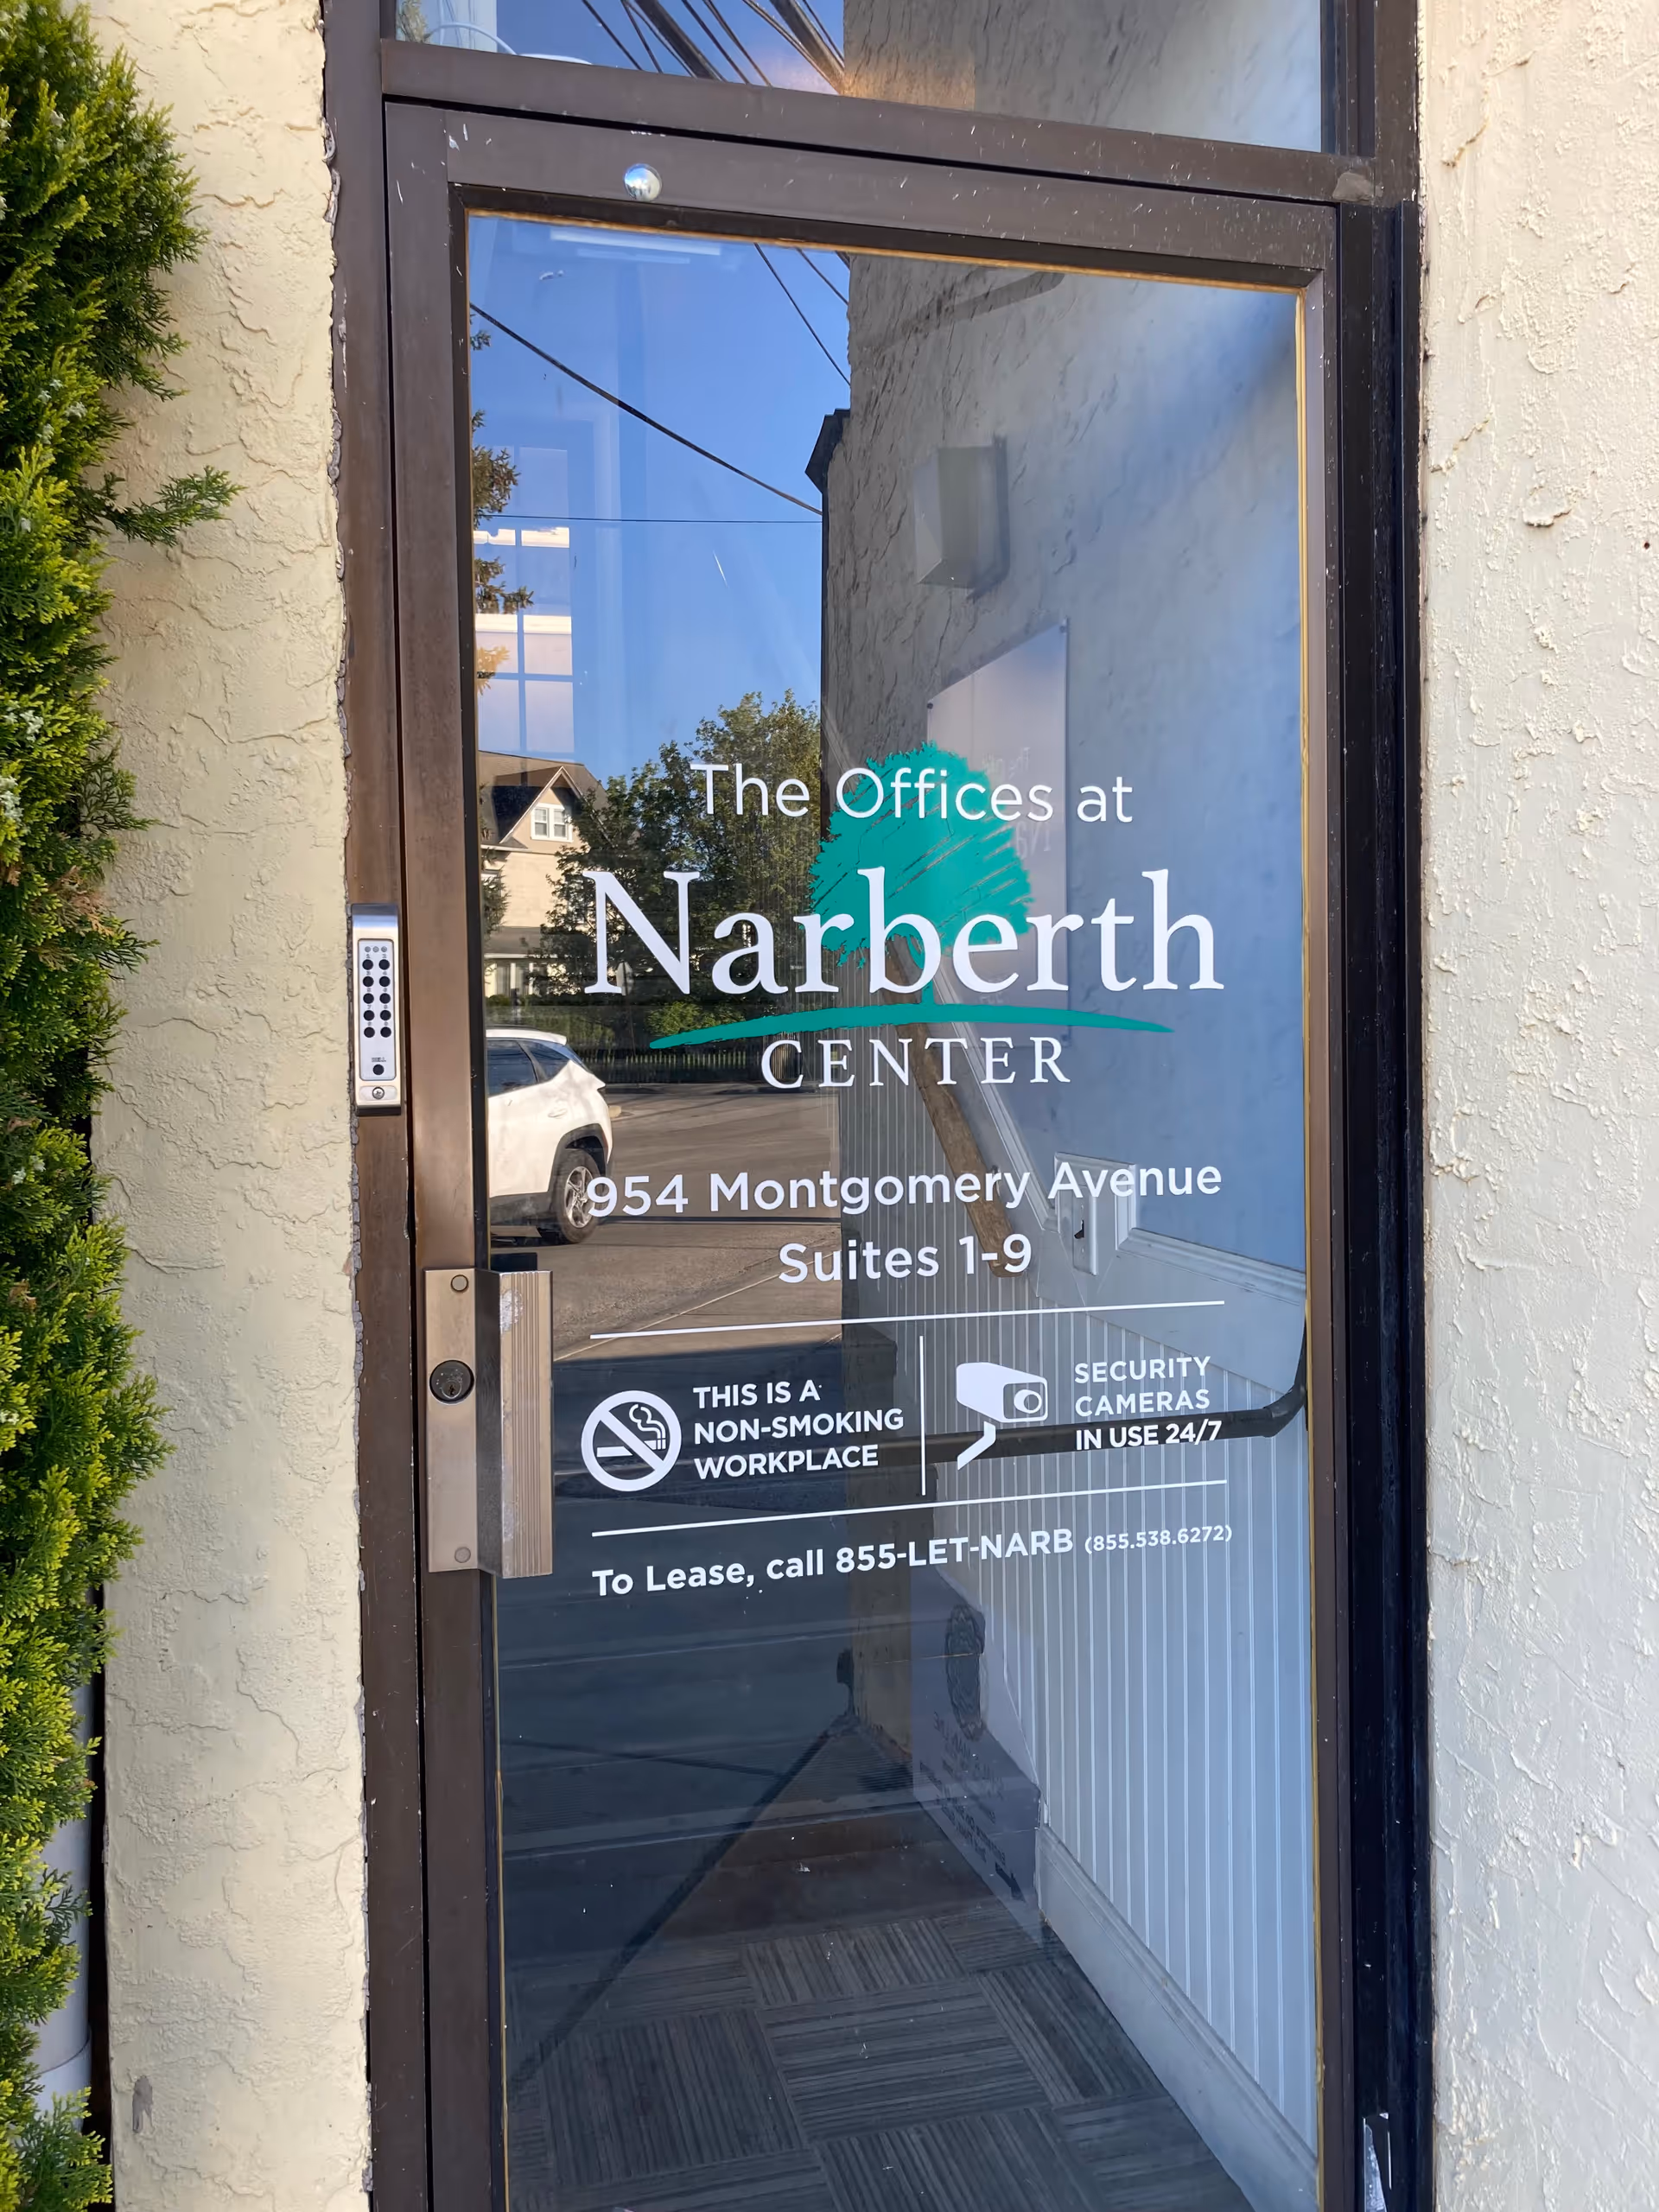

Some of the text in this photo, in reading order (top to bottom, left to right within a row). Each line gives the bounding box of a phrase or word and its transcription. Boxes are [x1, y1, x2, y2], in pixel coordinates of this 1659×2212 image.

[690, 763, 1133, 823] The Offices at
[582, 867, 1224, 995] Narberth
[761, 1037, 1071, 1089] CENTER
[587, 1162, 1222, 1217] 954 Montgomery Avenue
[779, 1233, 1032, 1283] Suites 1-9
[1074, 1356, 1211, 1383] SECURITY
[693, 1380, 821, 1408] THIS IS A
[1075, 1389, 1210, 1417] CAMERAS
[694, 1407, 905, 1446] NON-SMOKING
[1076, 1419, 1222, 1451] IN USE 24/7
[694, 1444, 879, 1479] WORKPLACE
[592, 1524, 1232, 1596] To Lease, call 855-LET-NARB (855.538.6272)
